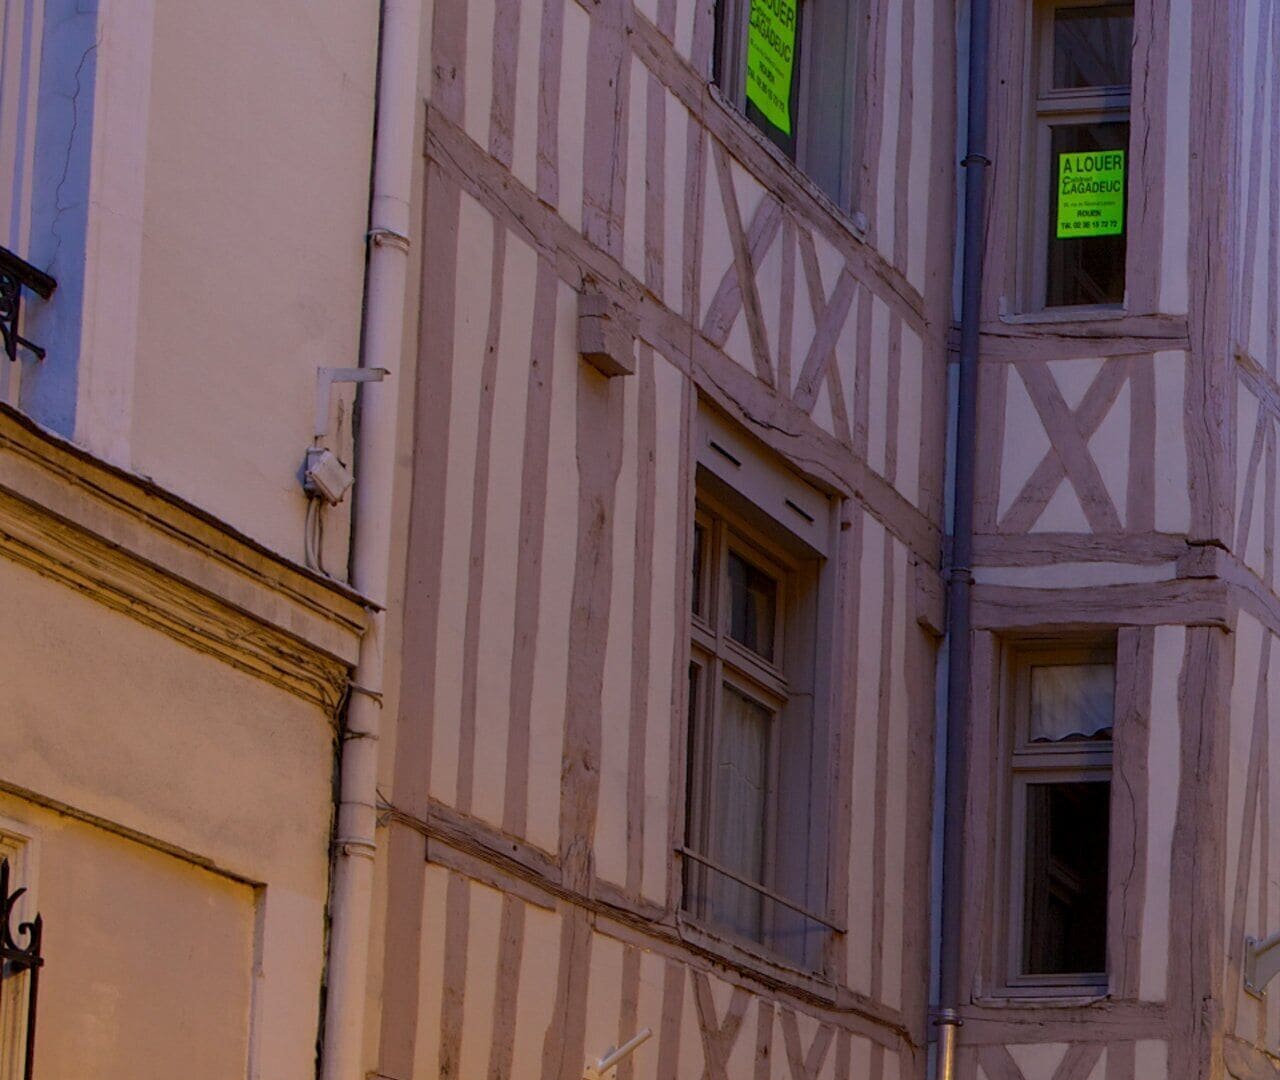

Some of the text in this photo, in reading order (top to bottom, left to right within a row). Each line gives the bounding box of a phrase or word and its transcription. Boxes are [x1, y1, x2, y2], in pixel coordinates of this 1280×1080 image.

[1063, 154, 1122, 174] A LOUER
[1062, 180, 1121, 195] LAGADEUC
